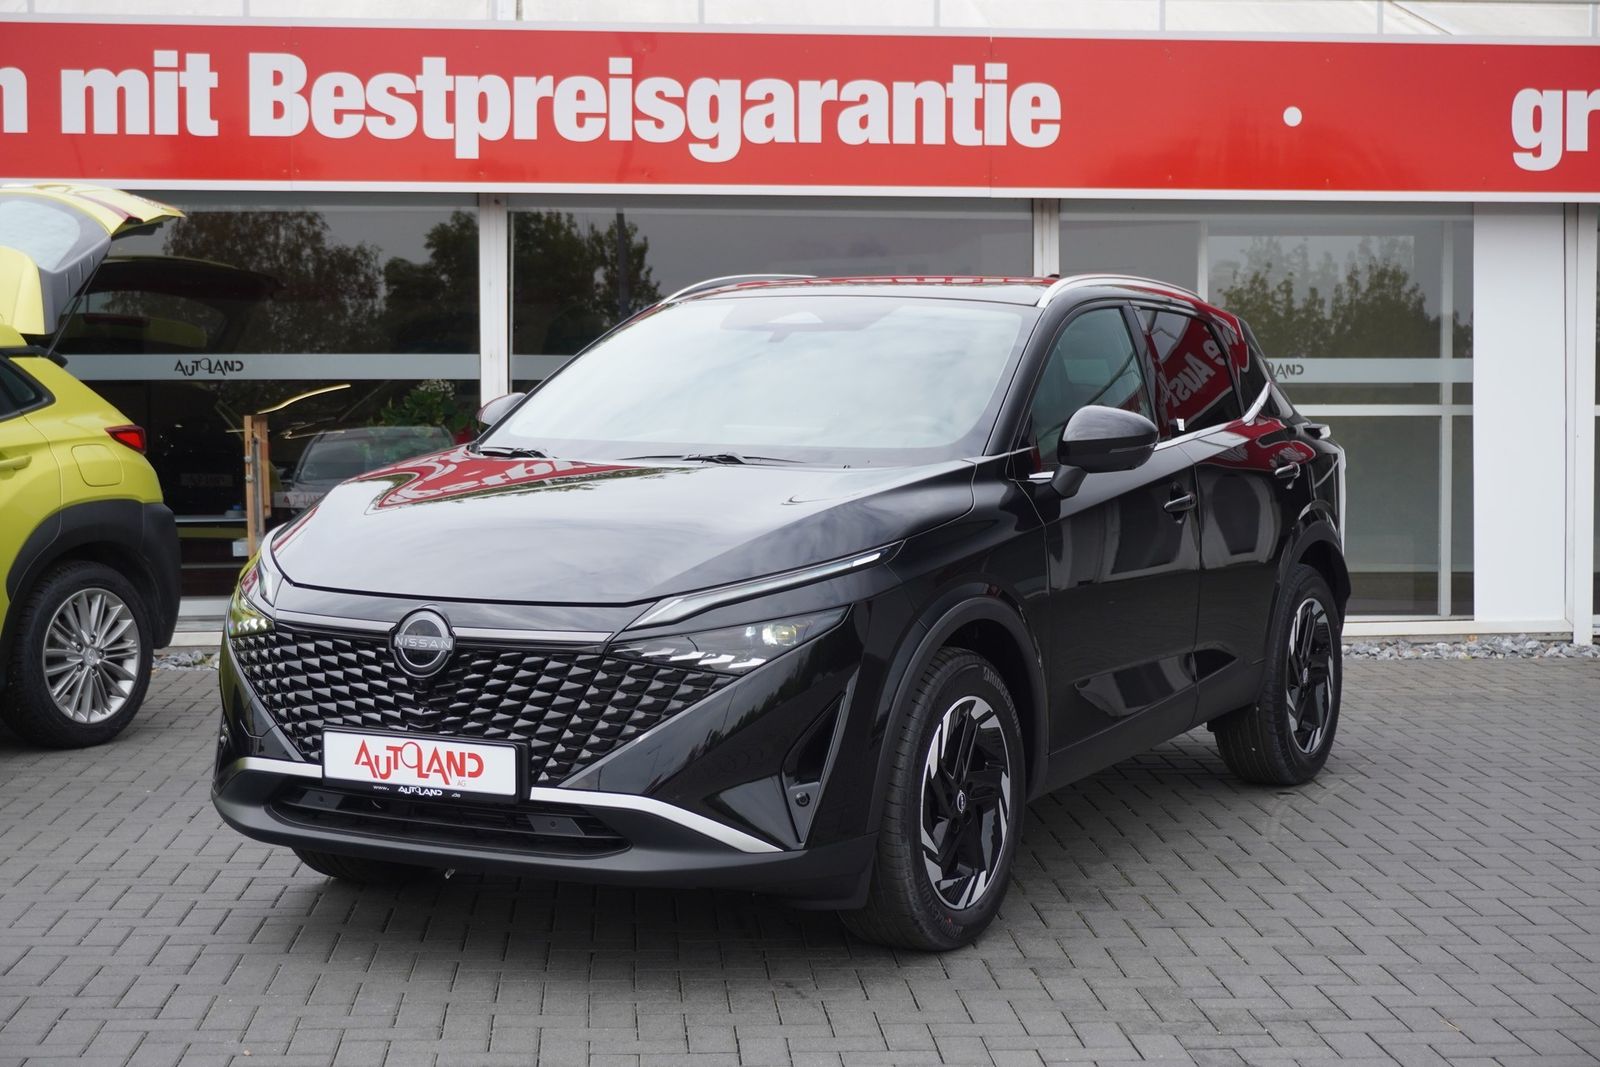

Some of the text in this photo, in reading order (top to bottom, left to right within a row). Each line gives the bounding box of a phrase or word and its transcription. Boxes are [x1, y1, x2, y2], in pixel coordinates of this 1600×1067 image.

[60, 50, 219, 137] mit
[248, 52, 1062, 163] Bestpreisgarantie
[394, 636, 452, 650] NISSAN
